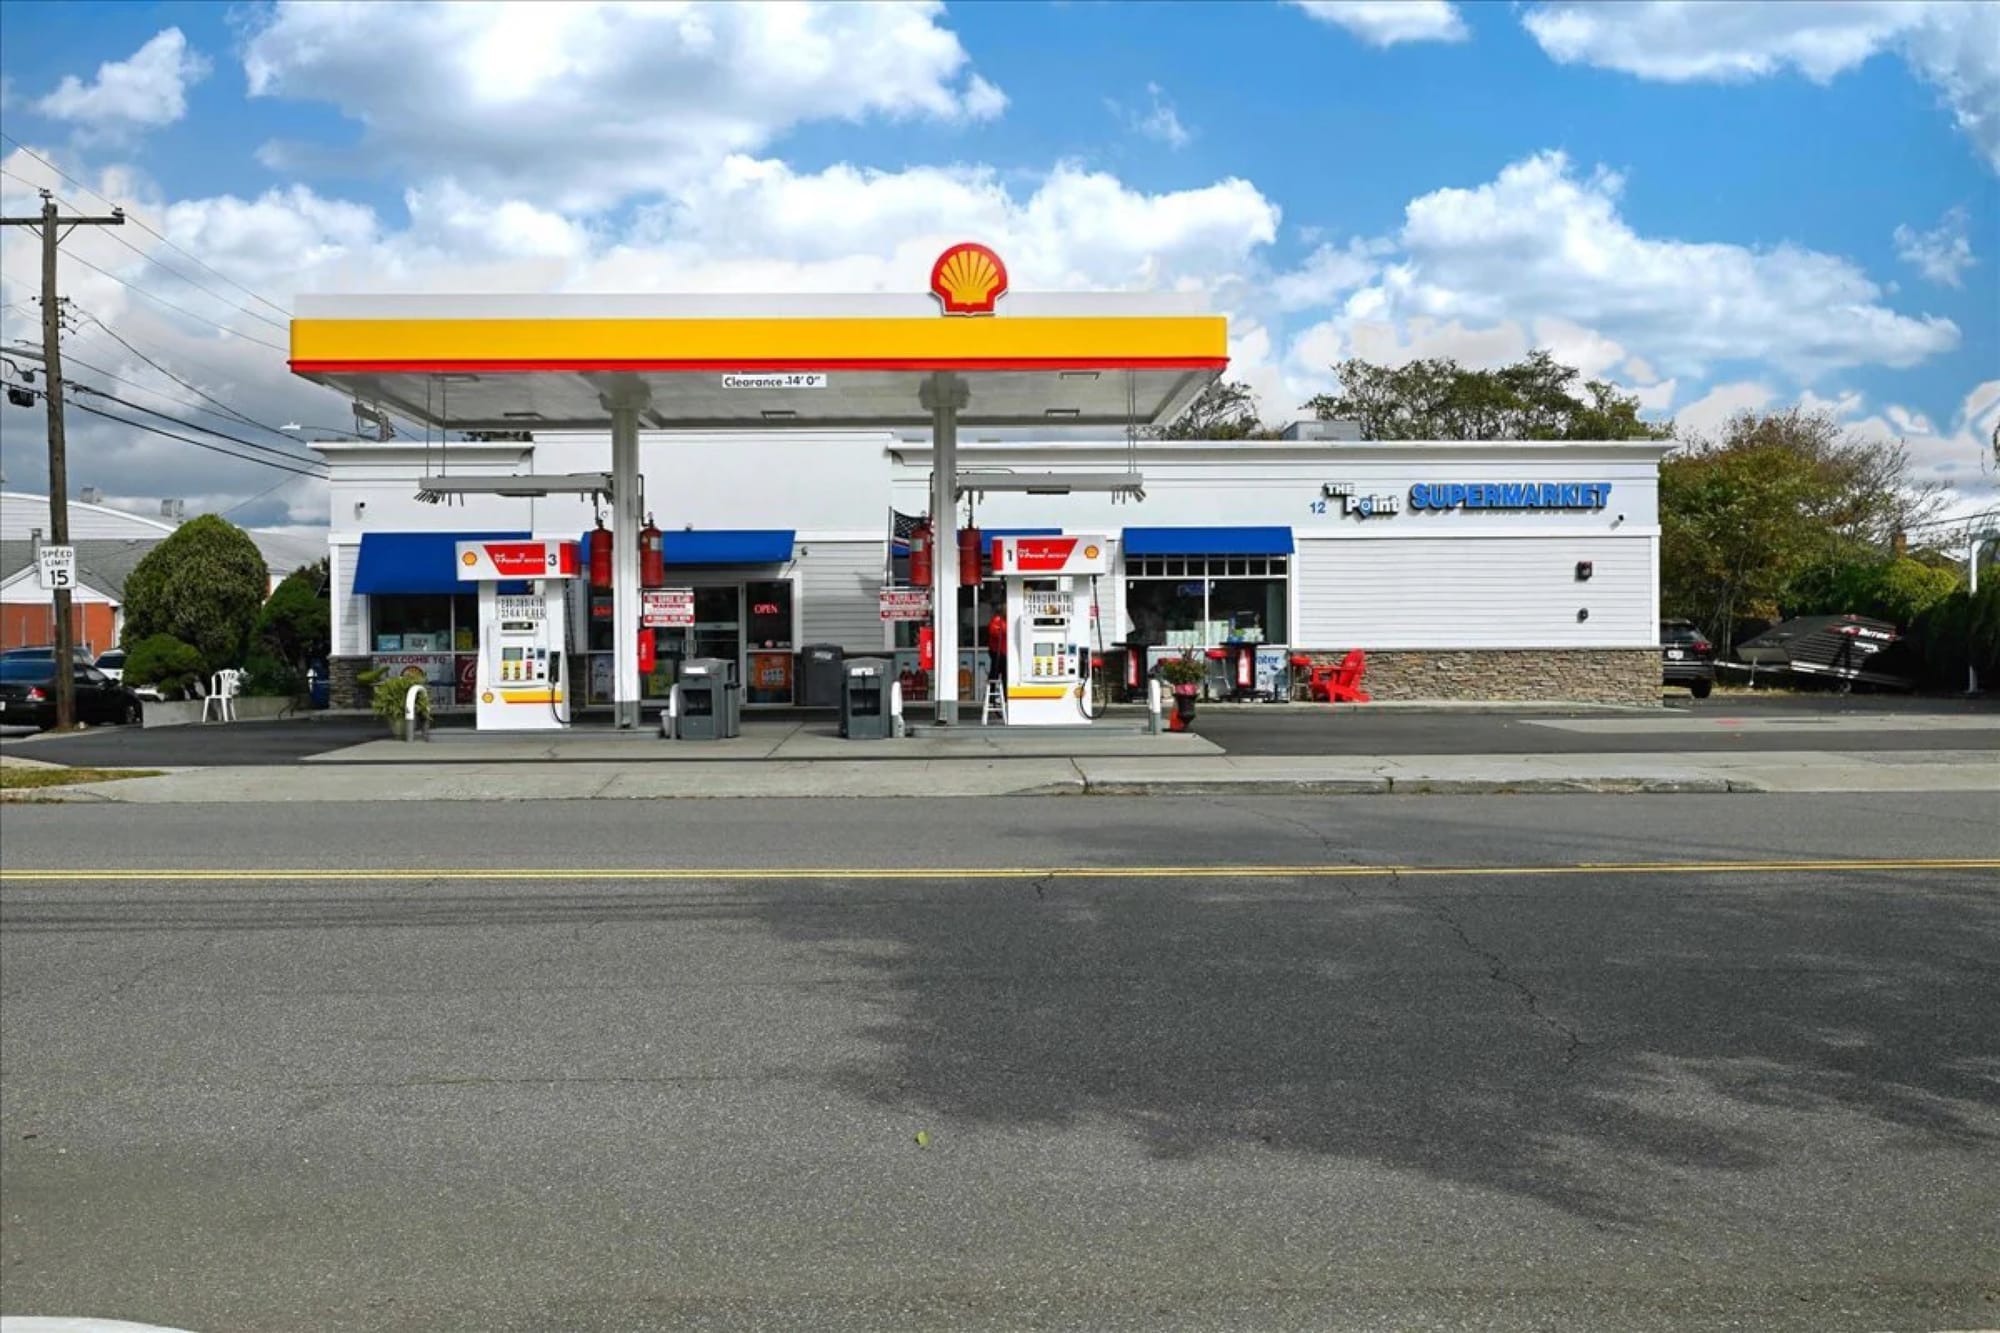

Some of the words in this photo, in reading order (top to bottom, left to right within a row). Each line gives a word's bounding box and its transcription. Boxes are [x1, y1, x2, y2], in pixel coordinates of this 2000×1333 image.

[723, 376, 783, 387] Clearance
[1325, 483, 1355, 496] THE
[1409, 482, 1612, 510] SUPERMARKET
[1310, 501, 1327, 514] 12
[1345, 496, 1399, 516] Point
[41, 550, 72, 558] SPEED
[547, 553, 558, 567] 3
[1007, 549, 1013, 562] 1
[50, 570, 69, 585] 15
[754, 603, 778, 614] OPEN
[1255, 652, 1280, 665] ater
